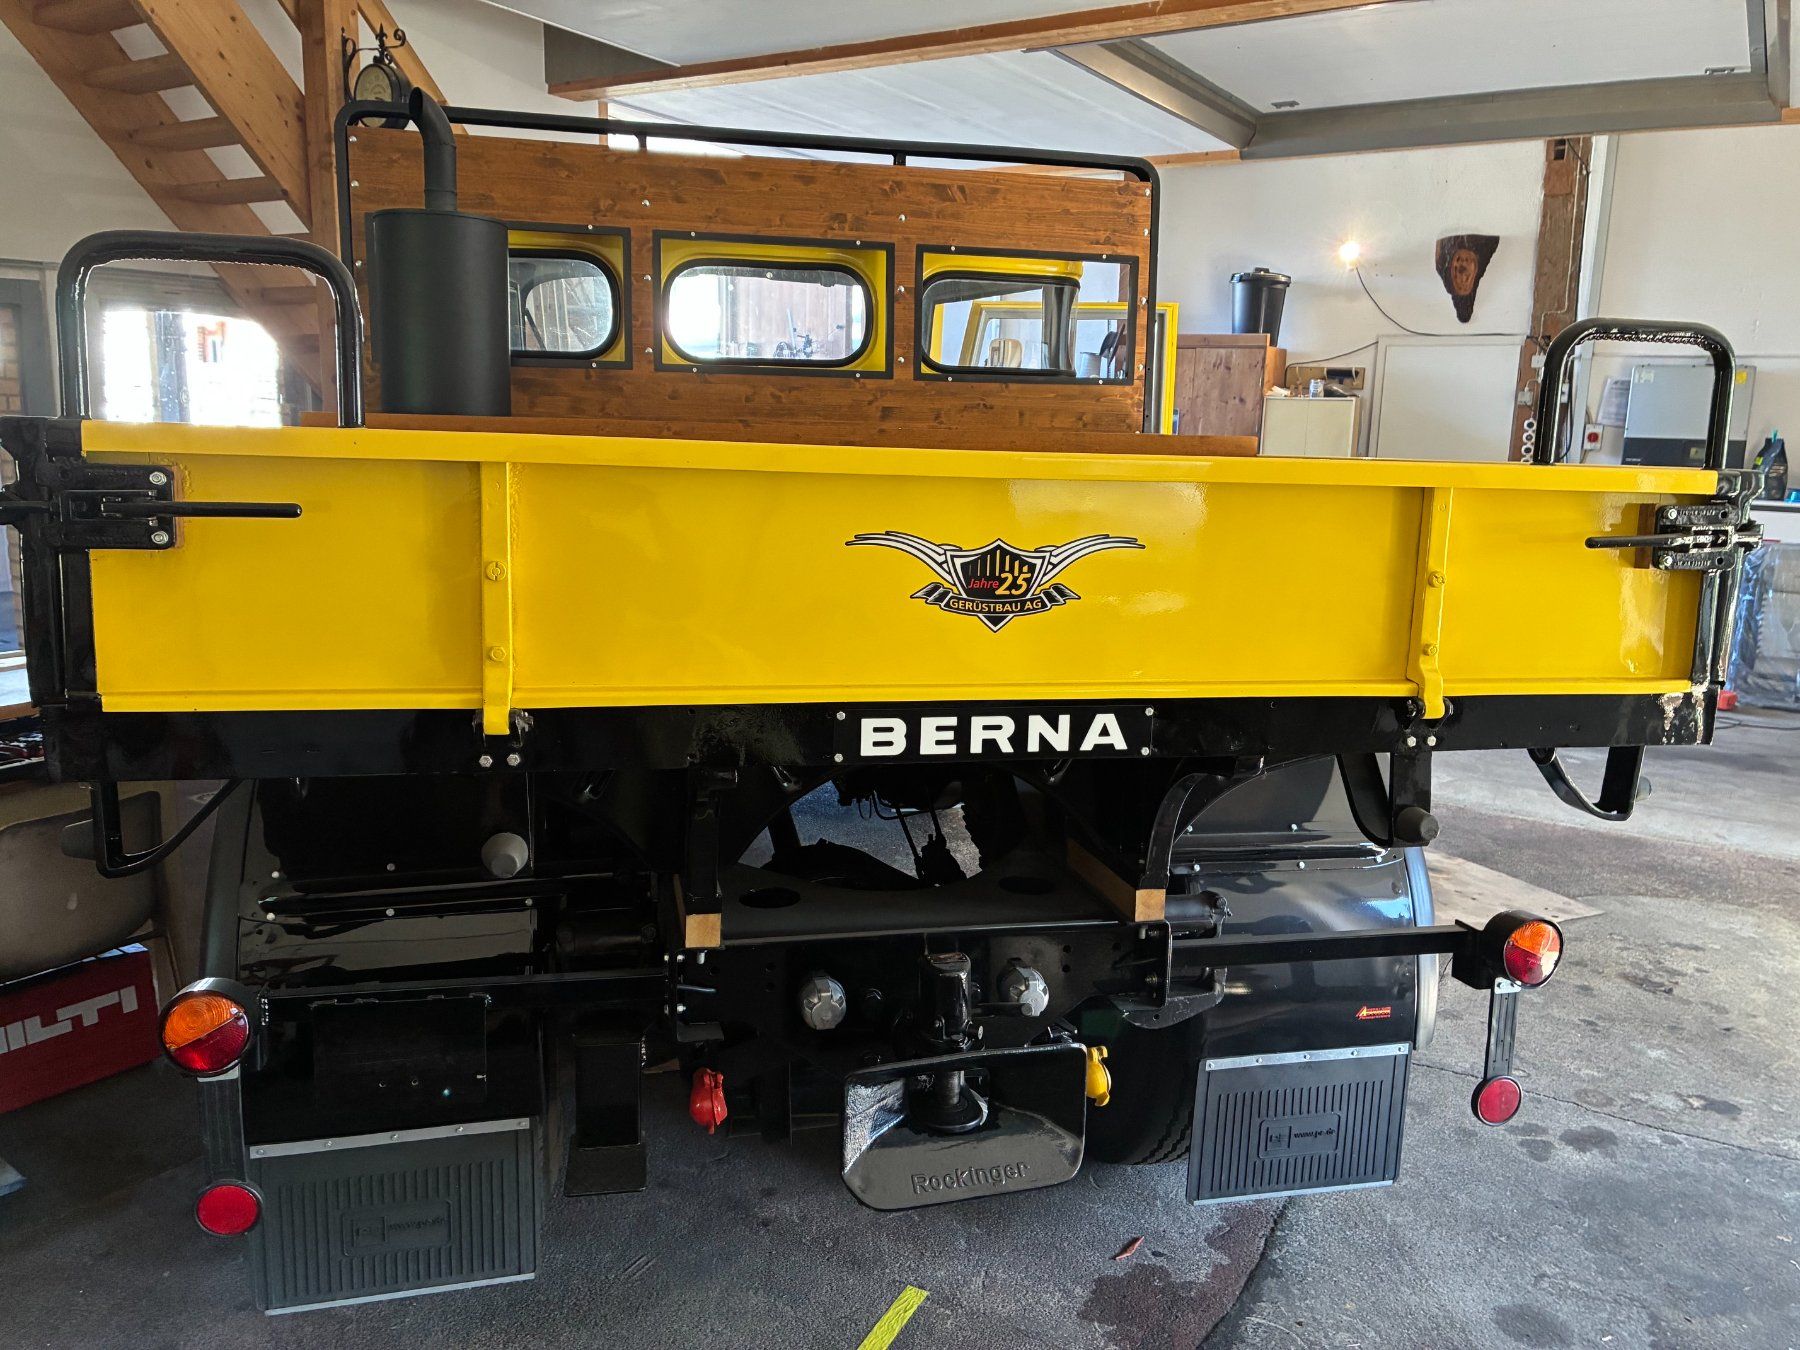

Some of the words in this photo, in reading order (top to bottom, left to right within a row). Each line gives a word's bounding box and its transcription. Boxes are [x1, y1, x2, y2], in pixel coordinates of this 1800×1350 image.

[968, 578, 999, 589] Jahre
[995, 572, 1032, 595] 25
[949, 598, 1021, 612] GERÜSTBAU
[1024, 599, 1042, 610] AG
[860, 713, 1128, 757] BERNA
[0, 985, 139, 1055] ILTI
[911, 1161, 1031, 1194] Rockinger
